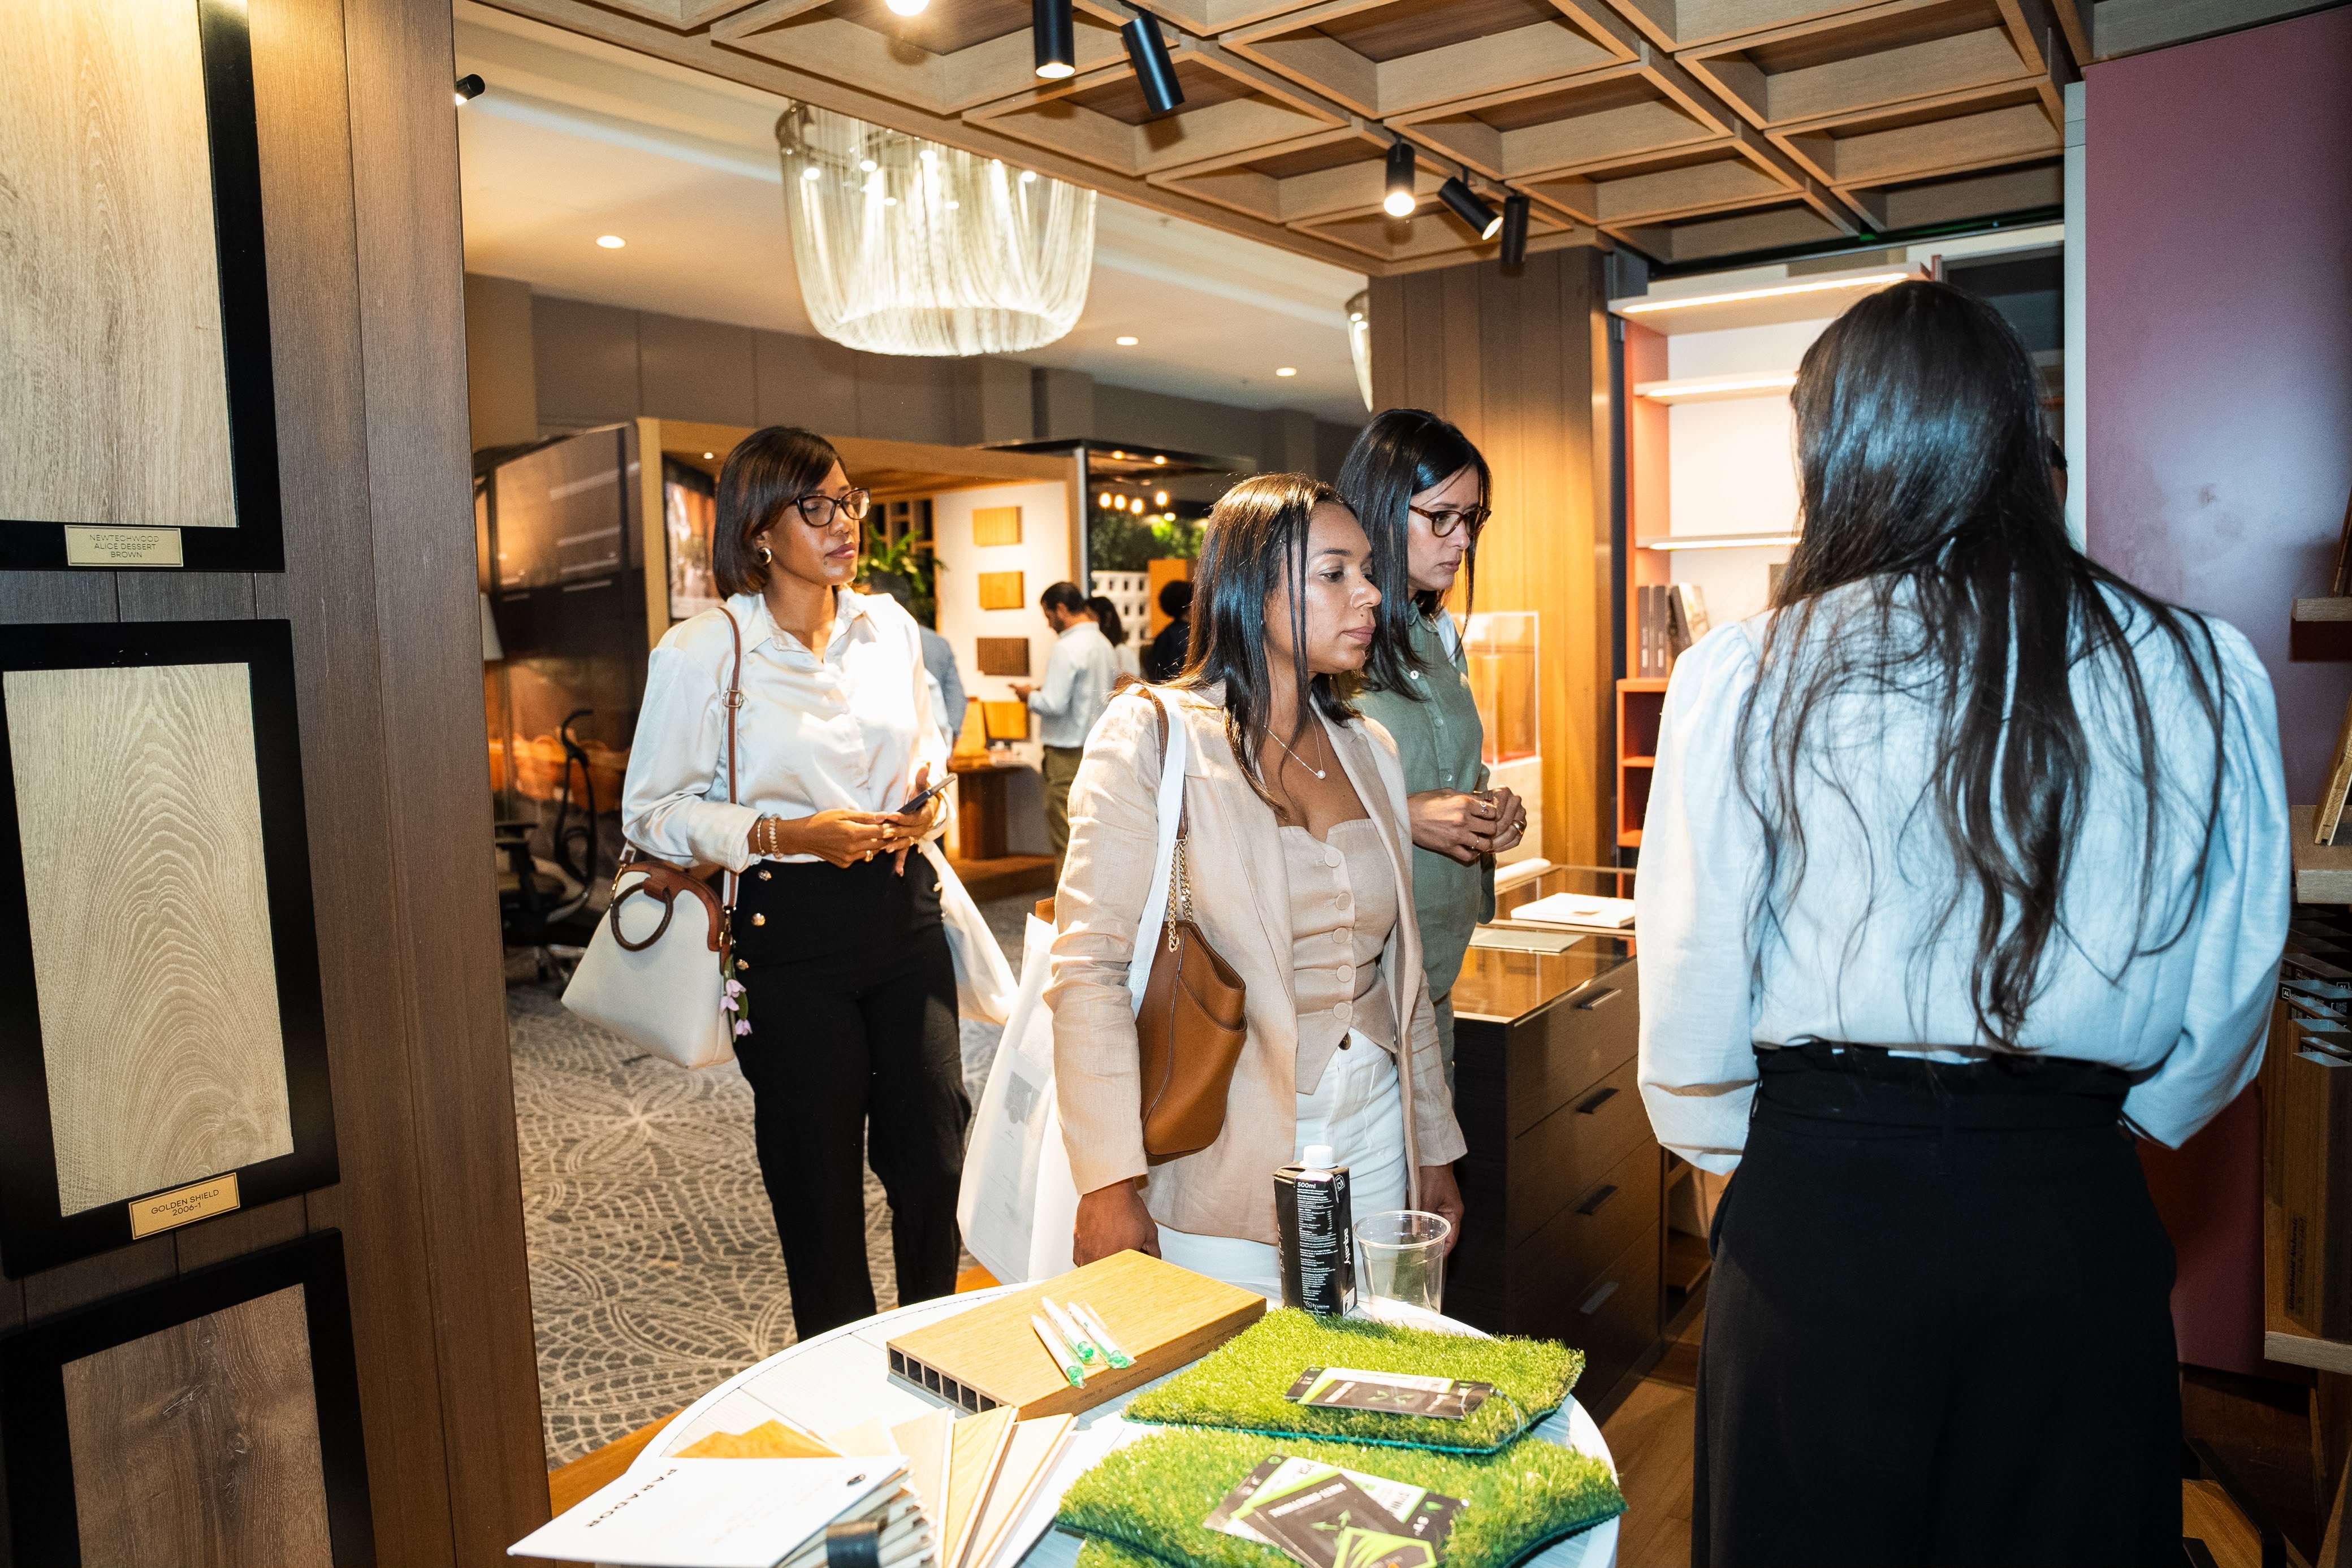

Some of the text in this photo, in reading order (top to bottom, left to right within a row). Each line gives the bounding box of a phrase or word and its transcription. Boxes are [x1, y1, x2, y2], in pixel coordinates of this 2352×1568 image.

[151, 1189, 219, 1214] GOLDEN SHIELD
[172, 1202, 201, 1216] 2006-1
[585, 1469, 678, 1527] PARADOR
